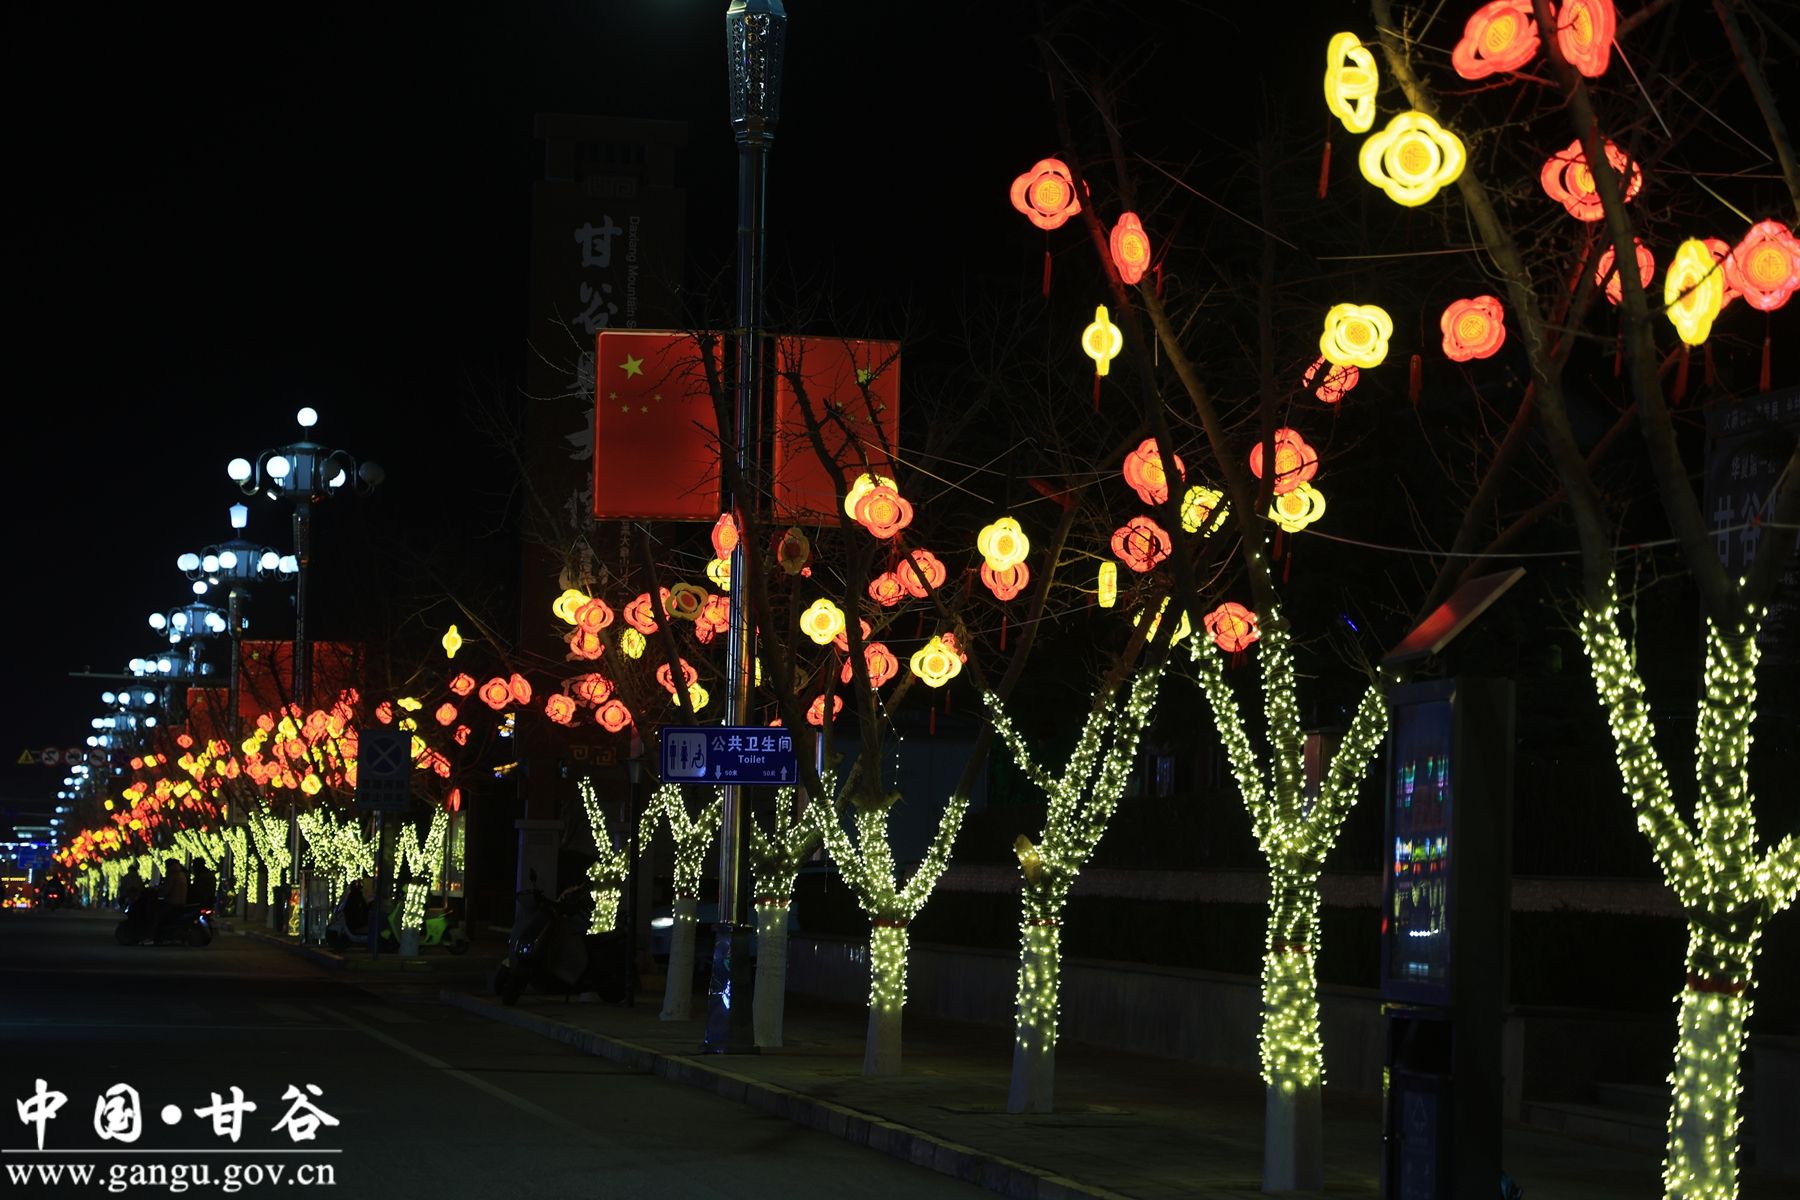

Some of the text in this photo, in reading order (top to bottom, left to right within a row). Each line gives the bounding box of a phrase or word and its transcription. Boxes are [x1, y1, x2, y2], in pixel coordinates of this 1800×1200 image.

[625, 215, 641, 262] Daxiang
[625, 264, 640, 318] Mountain
[711, 735, 793, 752] 公共卫生间
[737, 754, 766, 764] Toilet
